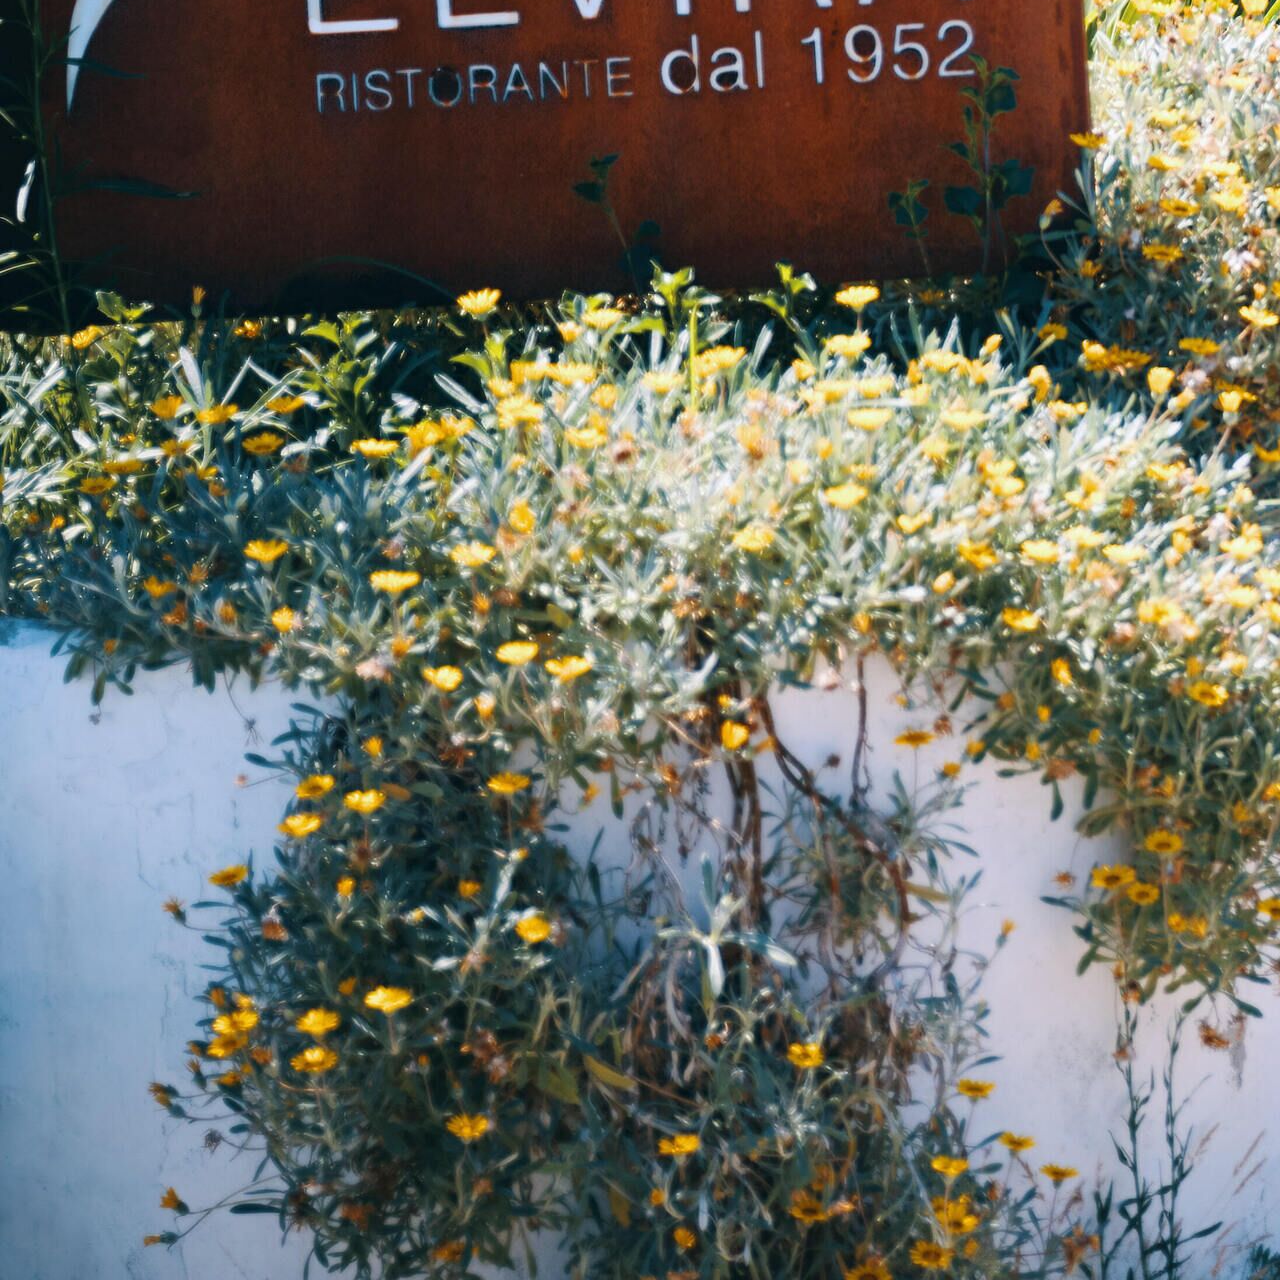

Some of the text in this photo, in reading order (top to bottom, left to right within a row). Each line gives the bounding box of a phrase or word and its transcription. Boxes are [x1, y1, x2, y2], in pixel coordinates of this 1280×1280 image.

[316, 19, 977, 113] RISTORANTE dal 1952
